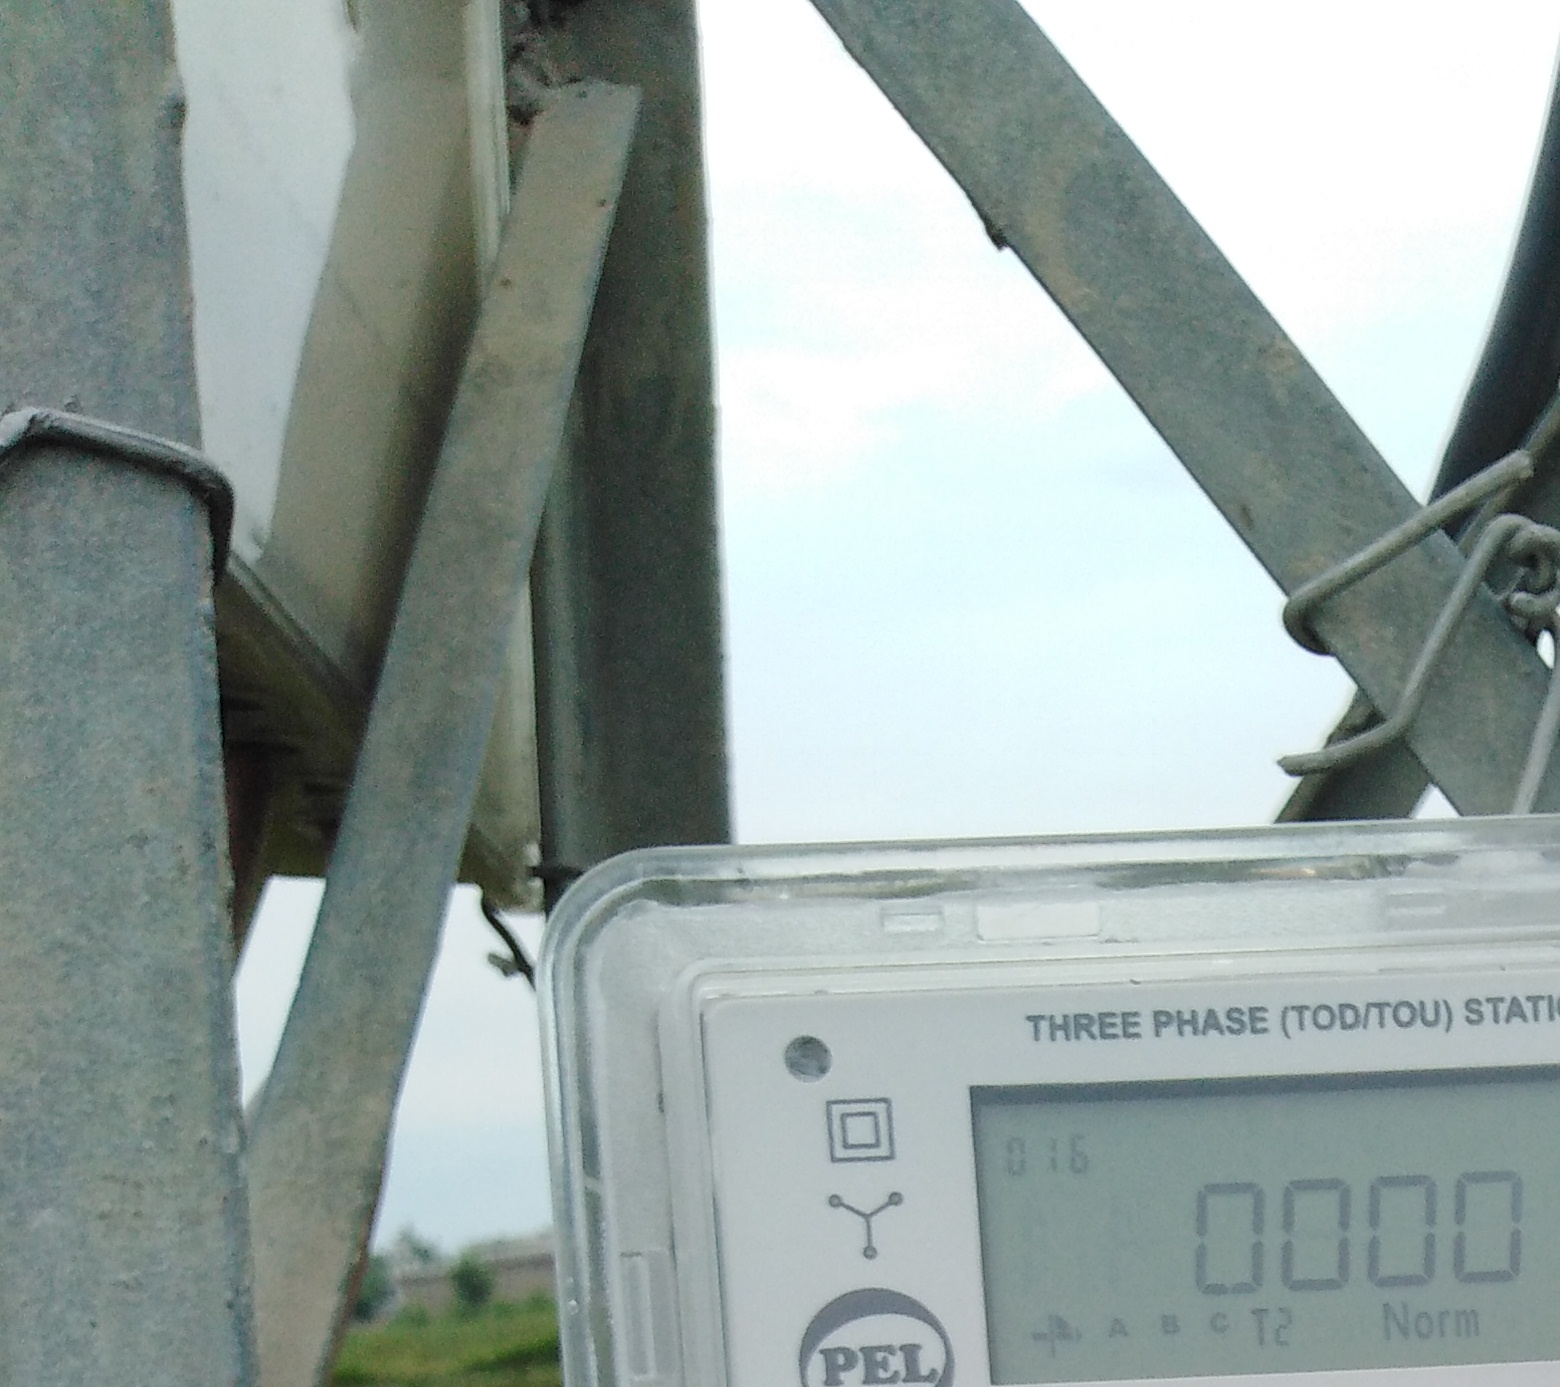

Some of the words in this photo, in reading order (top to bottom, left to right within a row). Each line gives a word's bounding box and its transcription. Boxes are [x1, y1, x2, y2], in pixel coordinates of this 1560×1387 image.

[1026, 1012, 1141, 1043] THREE
[1153, 1005, 1270, 1040] PHASE
[1281, 997, 1453, 1038] (TOD/TOU)
[1109, 1317, 1129, 1338] A
[1162, 1314, 1180, 1335] B
[1210, 1313, 1229, 1334] C
[1251, 1307, 1293, 1348] T2
[1383, 1302, 1480, 1341] Norm
[819, 1344, 939, 1386] PEL
